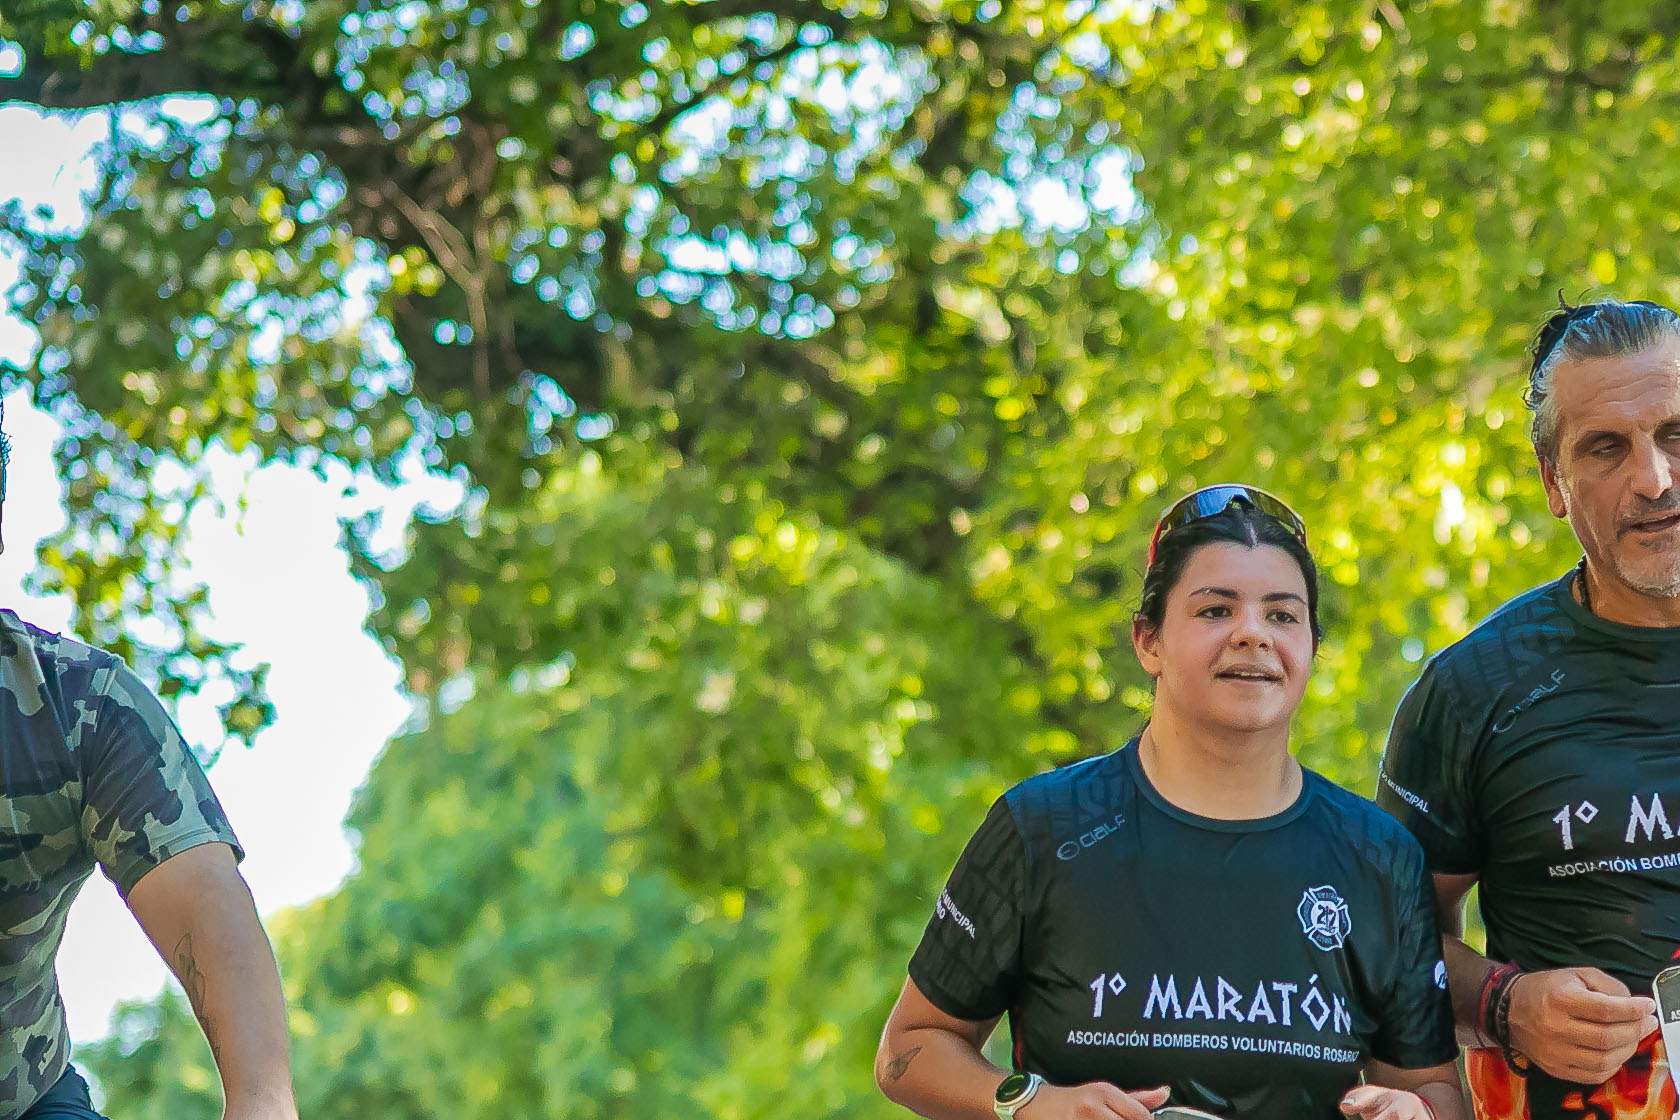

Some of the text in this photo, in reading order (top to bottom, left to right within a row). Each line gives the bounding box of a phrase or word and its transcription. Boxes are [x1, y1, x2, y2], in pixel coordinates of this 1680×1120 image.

[1547, 856, 1638, 878] ASOCIACIÓN
[1143, 973, 1352, 1036] MARATÓN
[1067, 1029, 1149, 1047] ASOCIACIÓN
[1152, 1033, 1227, 1050] BOMBEROS
[1230, 1036, 1321, 1059] VOLUNTARIOS
